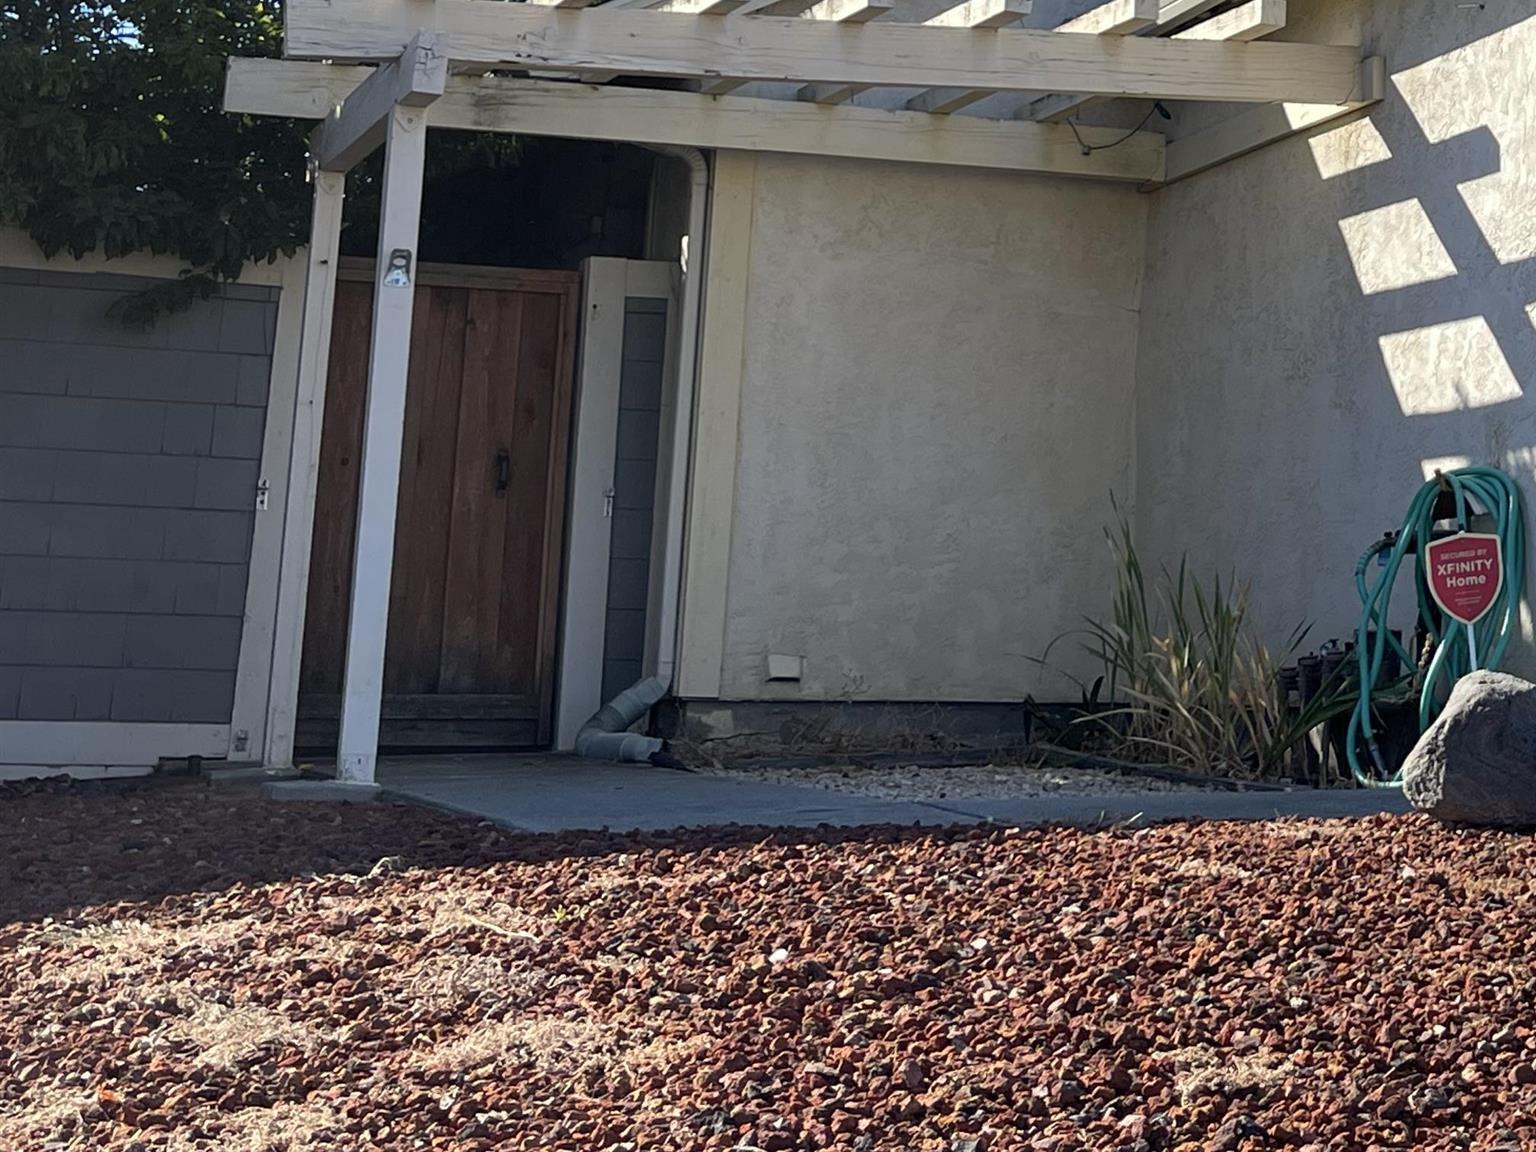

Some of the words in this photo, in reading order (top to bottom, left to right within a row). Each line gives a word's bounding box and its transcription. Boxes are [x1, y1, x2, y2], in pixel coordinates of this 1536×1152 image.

[1440, 550, 1475, 560] SECURED
[1437, 558, 1492, 576] XFINITY
[1446, 575, 1486, 588] Home
